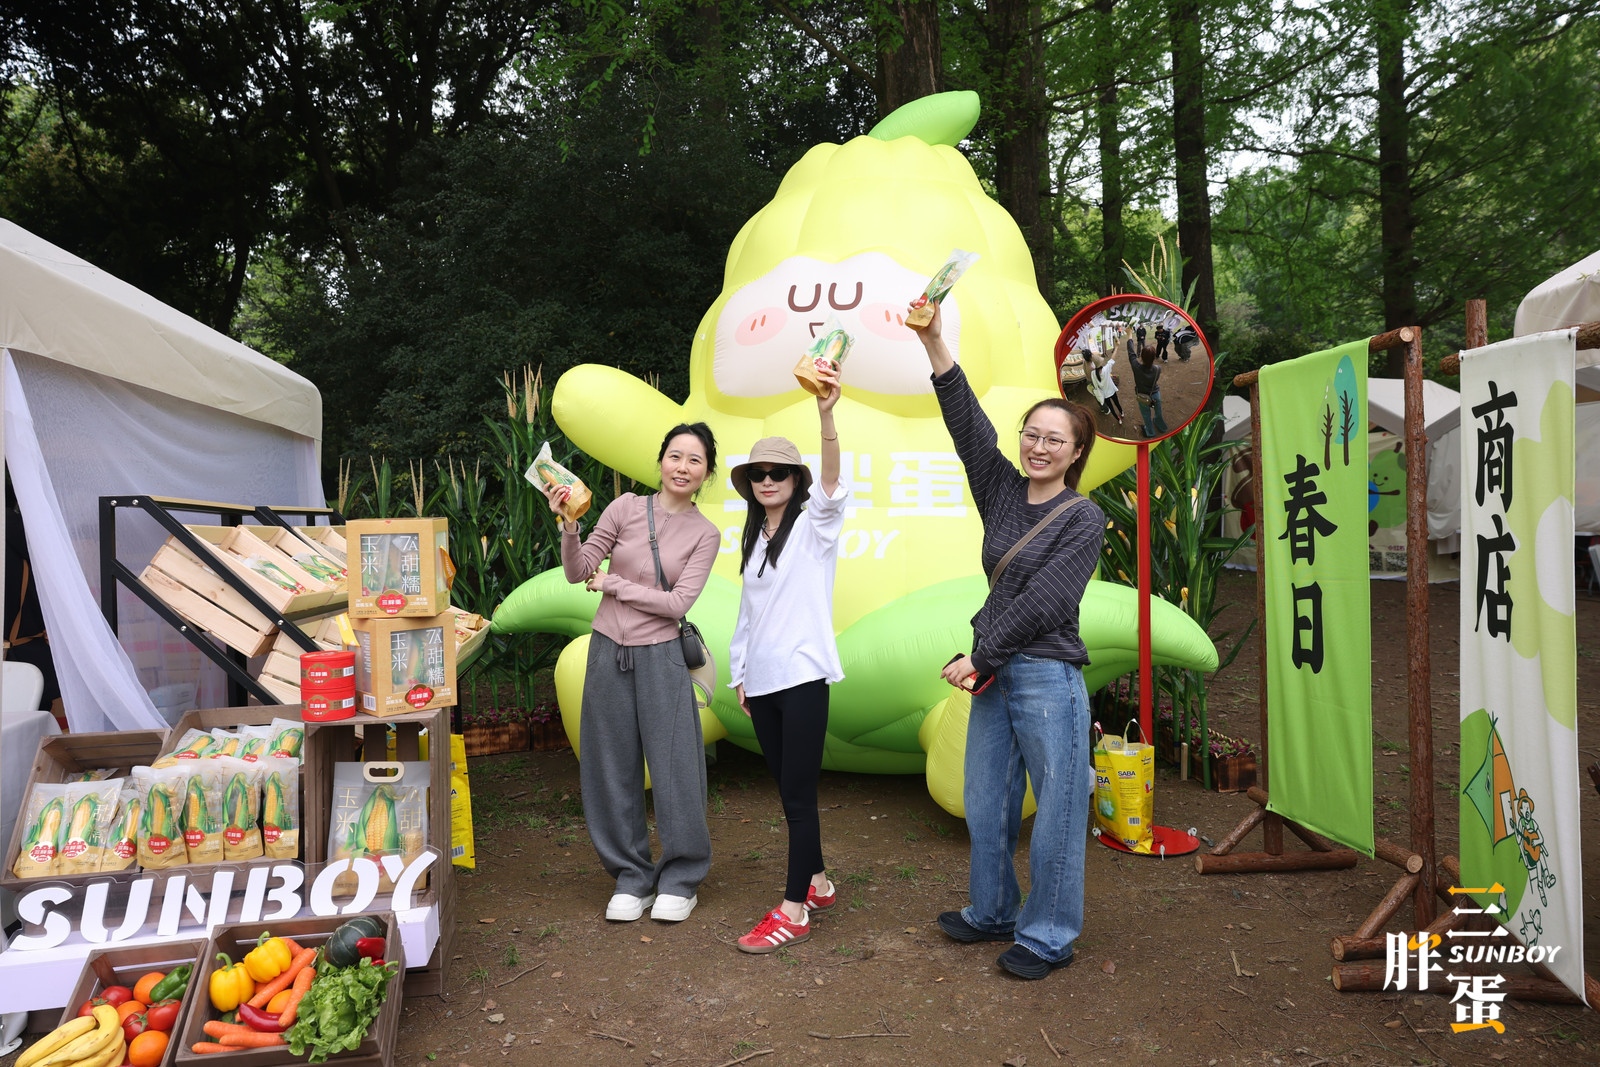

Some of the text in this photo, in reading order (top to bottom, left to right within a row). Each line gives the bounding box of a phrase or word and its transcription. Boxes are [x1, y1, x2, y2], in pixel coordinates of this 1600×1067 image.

[1277, 453, 1338, 674] 春日
[1471, 380, 1518, 643] 商店
[7, 850, 439, 951] SUNBOY
